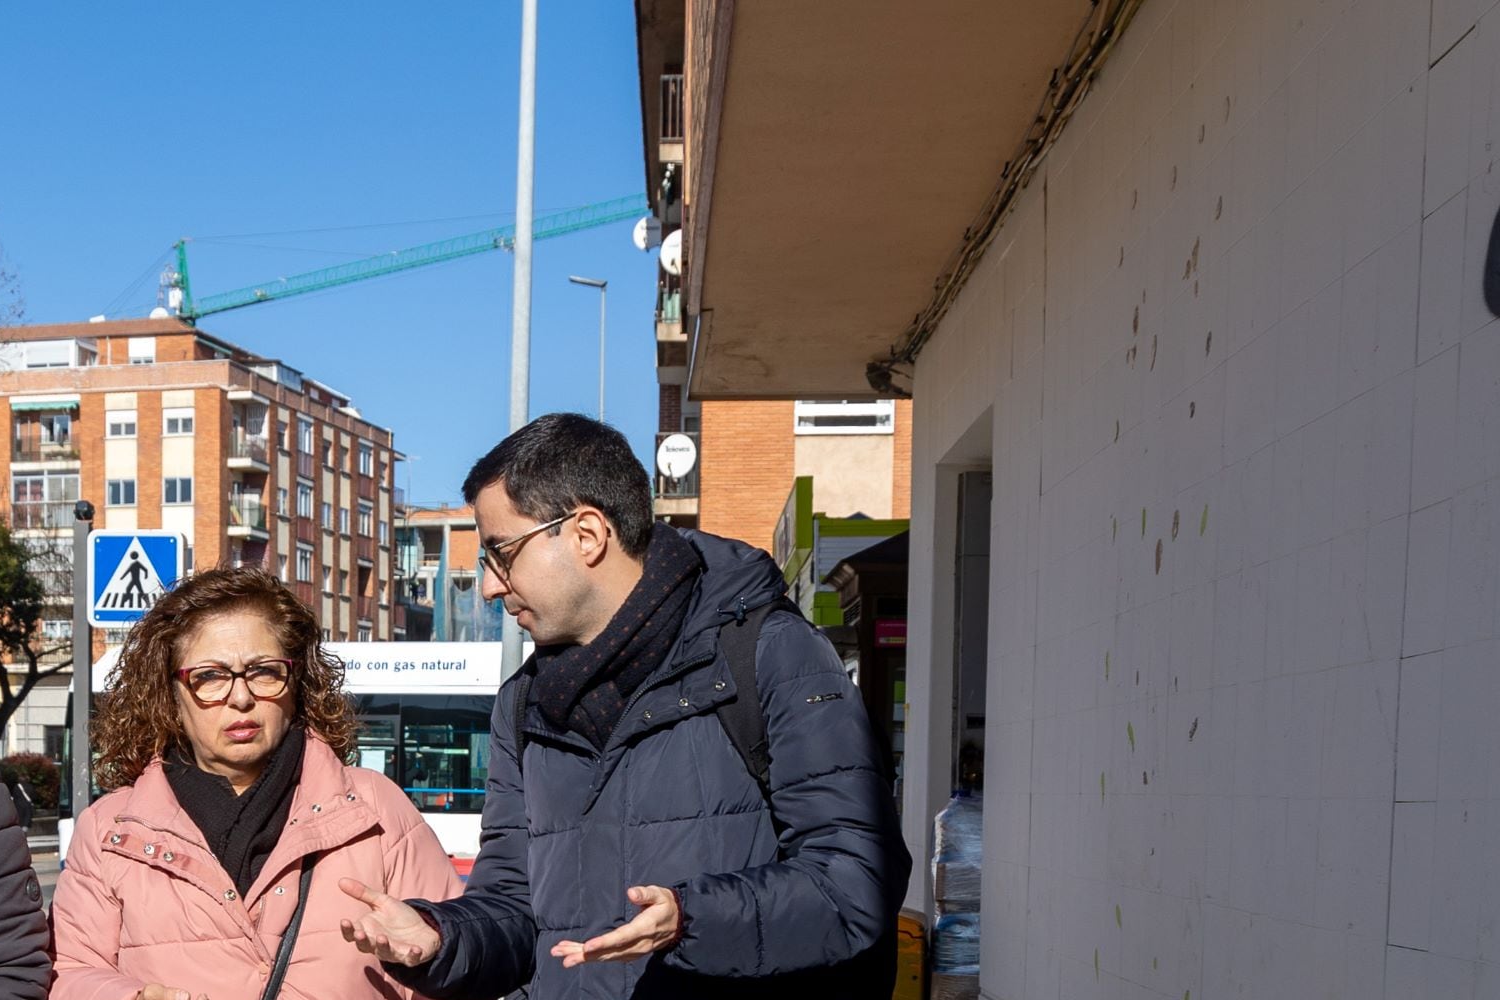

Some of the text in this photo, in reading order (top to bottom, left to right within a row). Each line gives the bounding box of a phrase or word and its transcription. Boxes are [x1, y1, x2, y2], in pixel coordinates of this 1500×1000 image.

[367, 661, 388, 670] con
[393, 661, 416, 672] gas
[421, 659, 466, 670] natural
